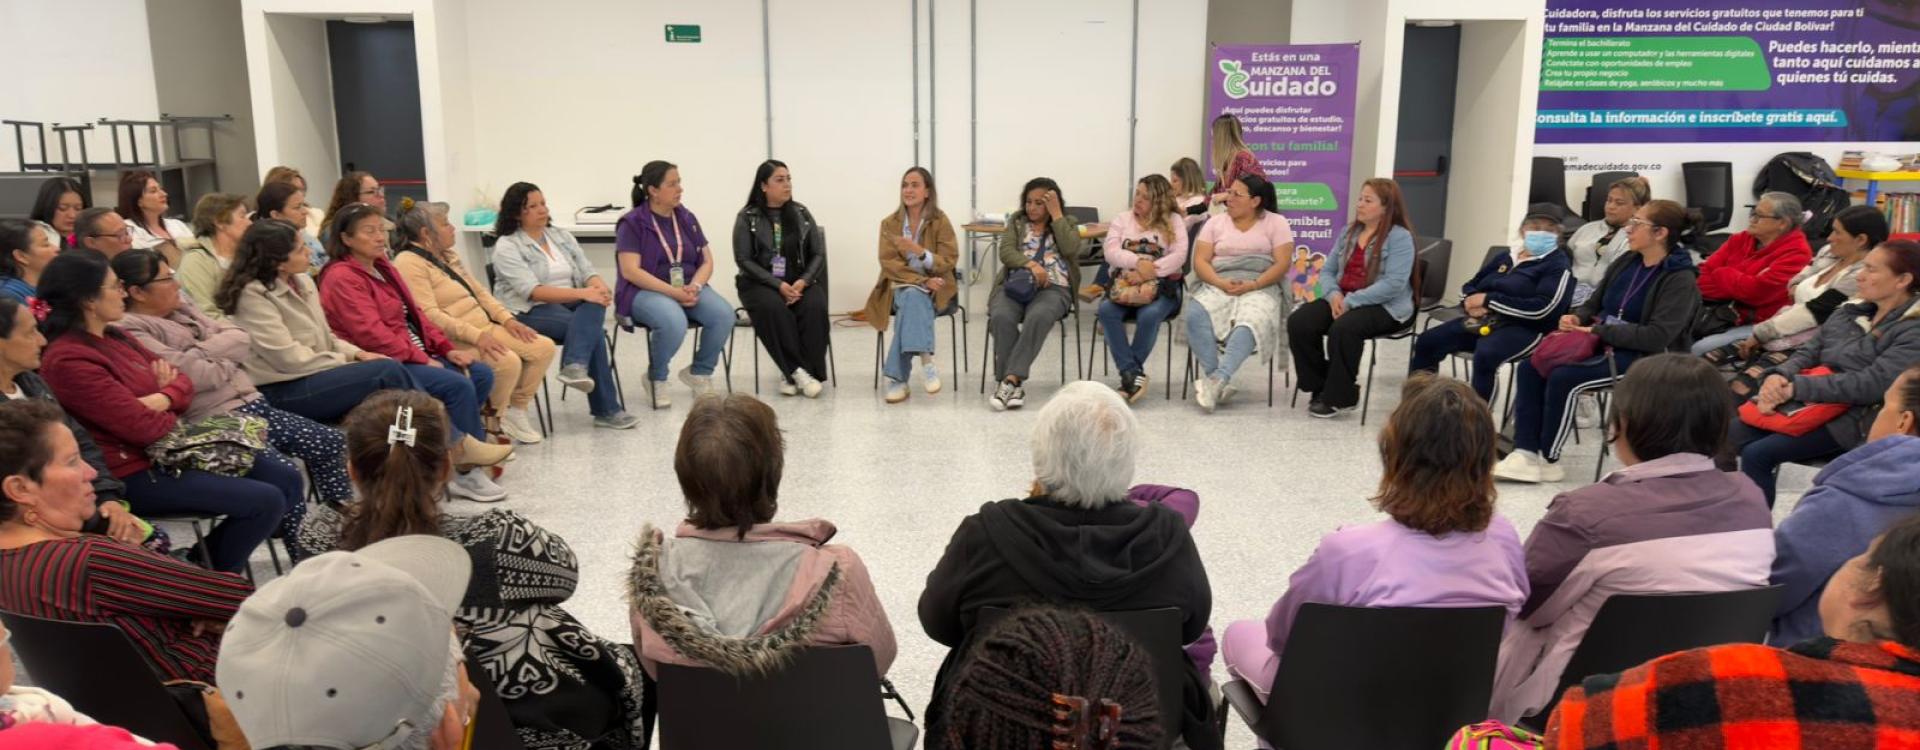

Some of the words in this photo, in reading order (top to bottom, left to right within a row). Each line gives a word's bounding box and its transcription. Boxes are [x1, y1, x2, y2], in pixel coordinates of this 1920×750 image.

[1602, 8, 1644, 18] disfruta
[1646, 8, 1662, 18] los
[1664, 8, 1710, 18] servicios
[1712, 8, 1760, 20] gratuitos
[1762, 10, 1783, 20] que
[1784, 8, 1828, 17] tenemos
[1830, 9, 1853, 19] para
[1856, 8, 1865, 17] ti
[1544, 23, 1556, 32] tu
[1559, 22, 1595, 32] familia
[1597, 24, 1610, 32] en
[1613, 22, 1622, 32] la
[1625, 22, 1672, 32] Manzana
[1674, 22, 1691, 32] del
[1693, 21, 1738, 32] Cuidado
[1739, 22, 1753, 31] de
[1755, 21, 1792, 31] Ciudad
[1794, 21, 1835, 31] Bolívar!
[1769, 40, 1817, 53] Puedes
[1820, 40, 1874, 54] hacerlo,
[1252, 53, 1280, 62] Estás
[1547, 50, 1578, 58] Aprende
[1613, 50, 1658, 58] computador
[1664, 59, 1693, 68] empleo
[1773, 57, 1810, 68] tanto
[1812, 57, 1844, 71] aquí
[1845, 57, 1910, 68] cuidamos
[1250, 66, 1306, 75] MANZANA
[1309, 66, 1331, 75] DEL
[1573, 69, 1598, 79] propio
[1599, 69, 1629, 79] negocio
[1777, 71, 1830, 86] quienes
[1833, 71, 1848, 83] tú
[1850, 71, 1897, 83] cuidas.
[1223, 69, 1337, 99] Cuidado
[1244, 107, 1274, 115] puedes
[1276, 106, 1312, 114] disfrutar
[1259, 116, 1296, 125] gratuitos
[1536, 111, 1586, 123] onsulta
[1590, 111, 1602, 123] la
[1606, 111, 1686, 123] información
[1688, 114, 1696, 122] e
[1700, 111, 1764, 123] inscríbete
[1766, 111, 1802, 125] gratis
[1805, 111, 1838, 125] aquí.
[1272, 142, 1285, 151] tu
[1289, 141, 1338, 151] familia!
[1301, 229, 1332, 240] aquí!
